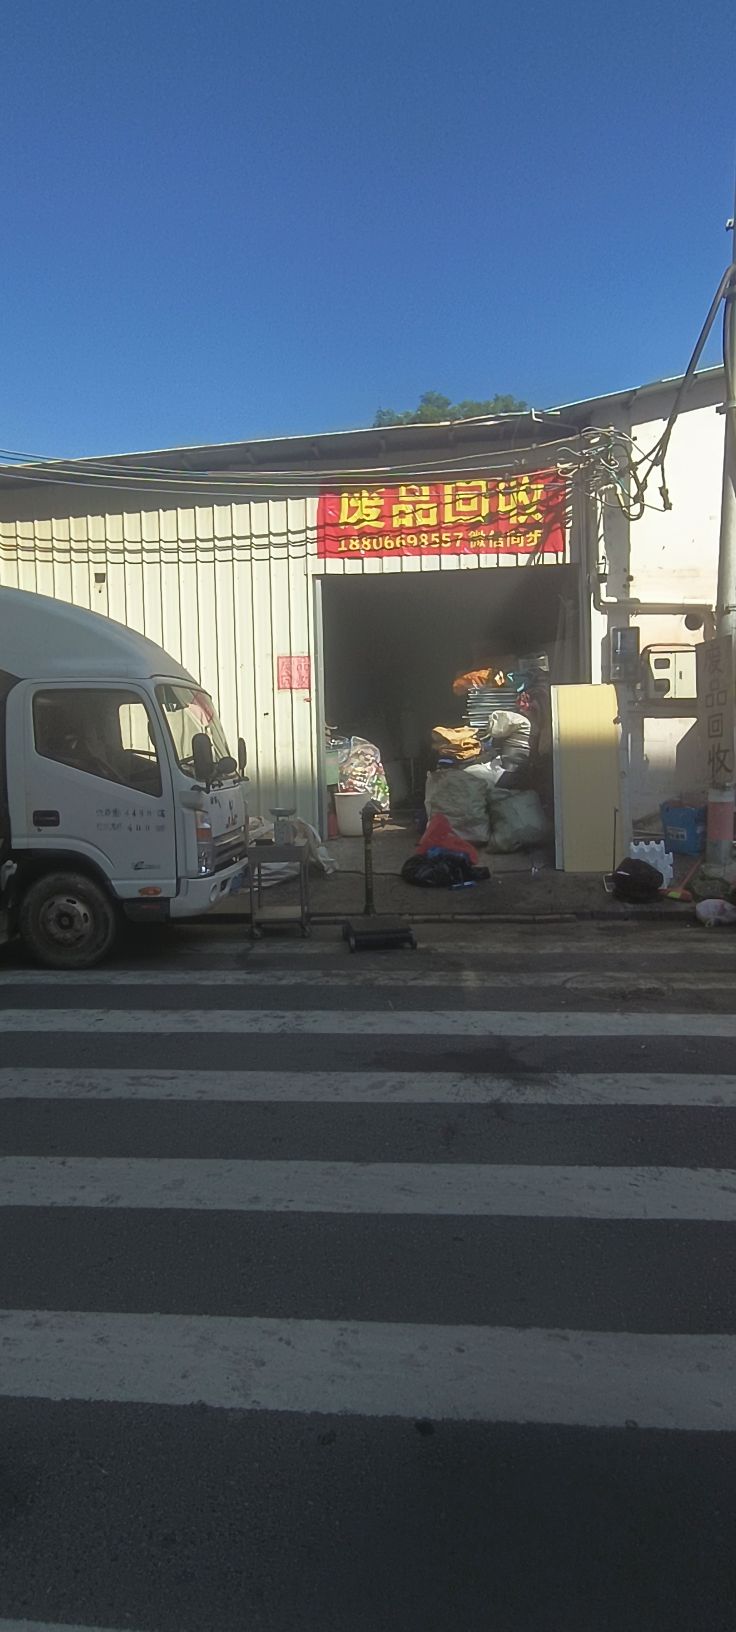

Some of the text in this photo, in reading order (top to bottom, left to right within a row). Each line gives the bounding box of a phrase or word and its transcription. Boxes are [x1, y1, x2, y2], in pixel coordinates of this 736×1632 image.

[338, 476, 545, 529] 废品回收
[337, 532, 463, 552] 18806698557
